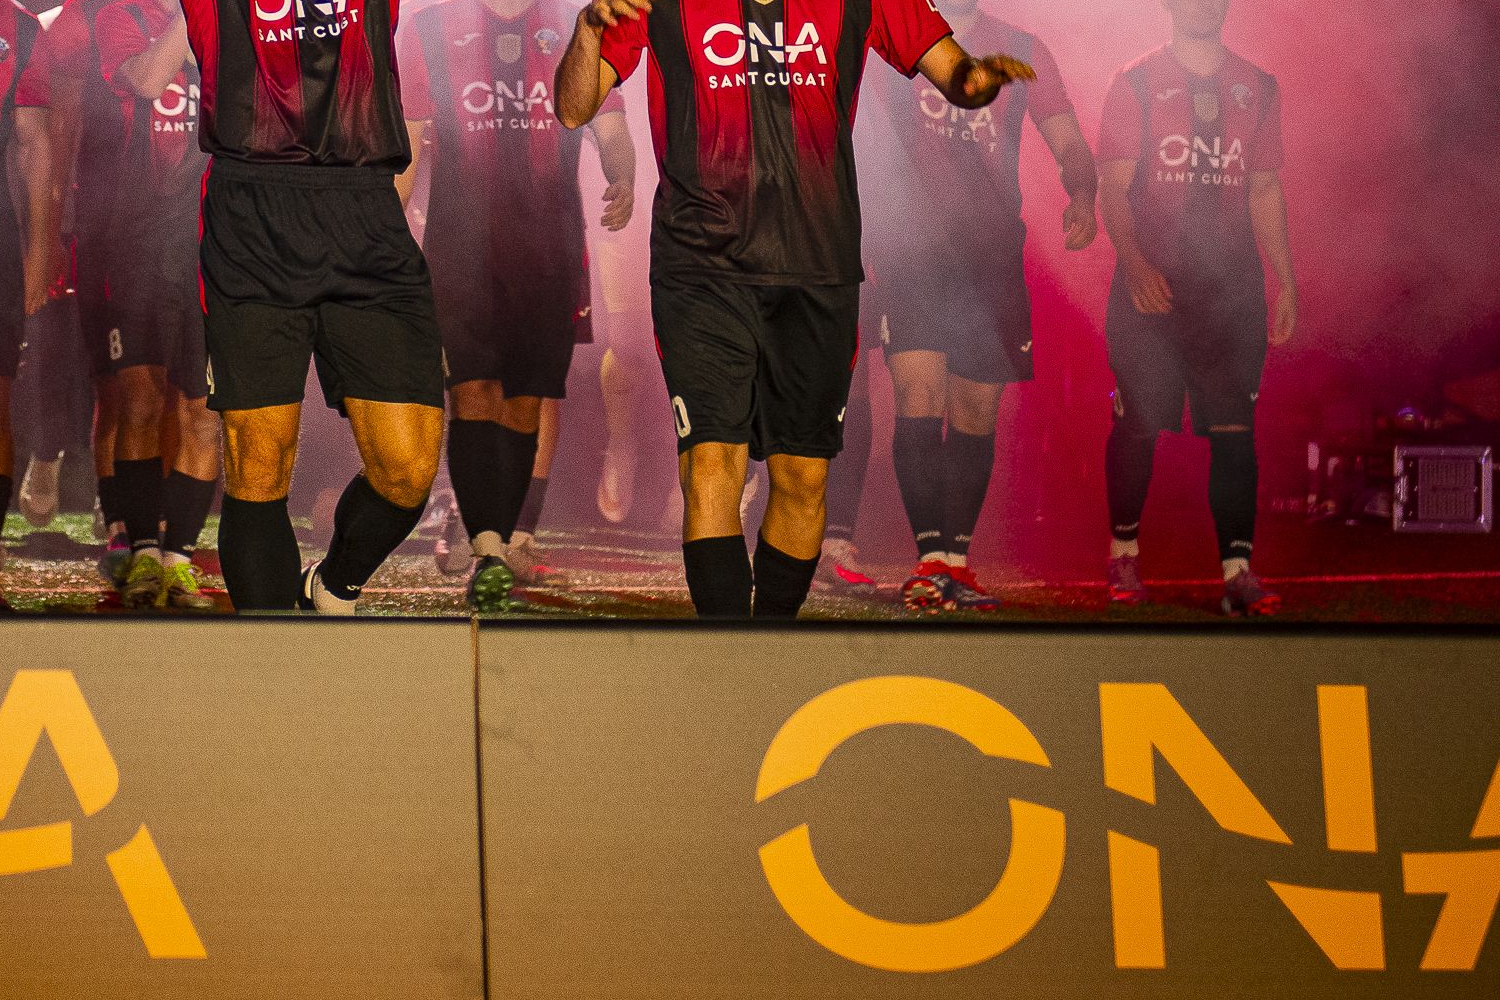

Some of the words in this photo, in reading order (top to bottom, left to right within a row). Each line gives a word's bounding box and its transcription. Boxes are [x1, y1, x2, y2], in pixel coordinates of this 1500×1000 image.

[703, 22, 828, 66] ONA
[708, 72, 759, 89] SANT
[764, 72, 827, 87] CUGAT
[461, 80, 554, 114] ONA
[153, 121, 195, 132] SANT
[467, 118, 503, 132] SANT
[1159, 135, 1246, 171] ONA
